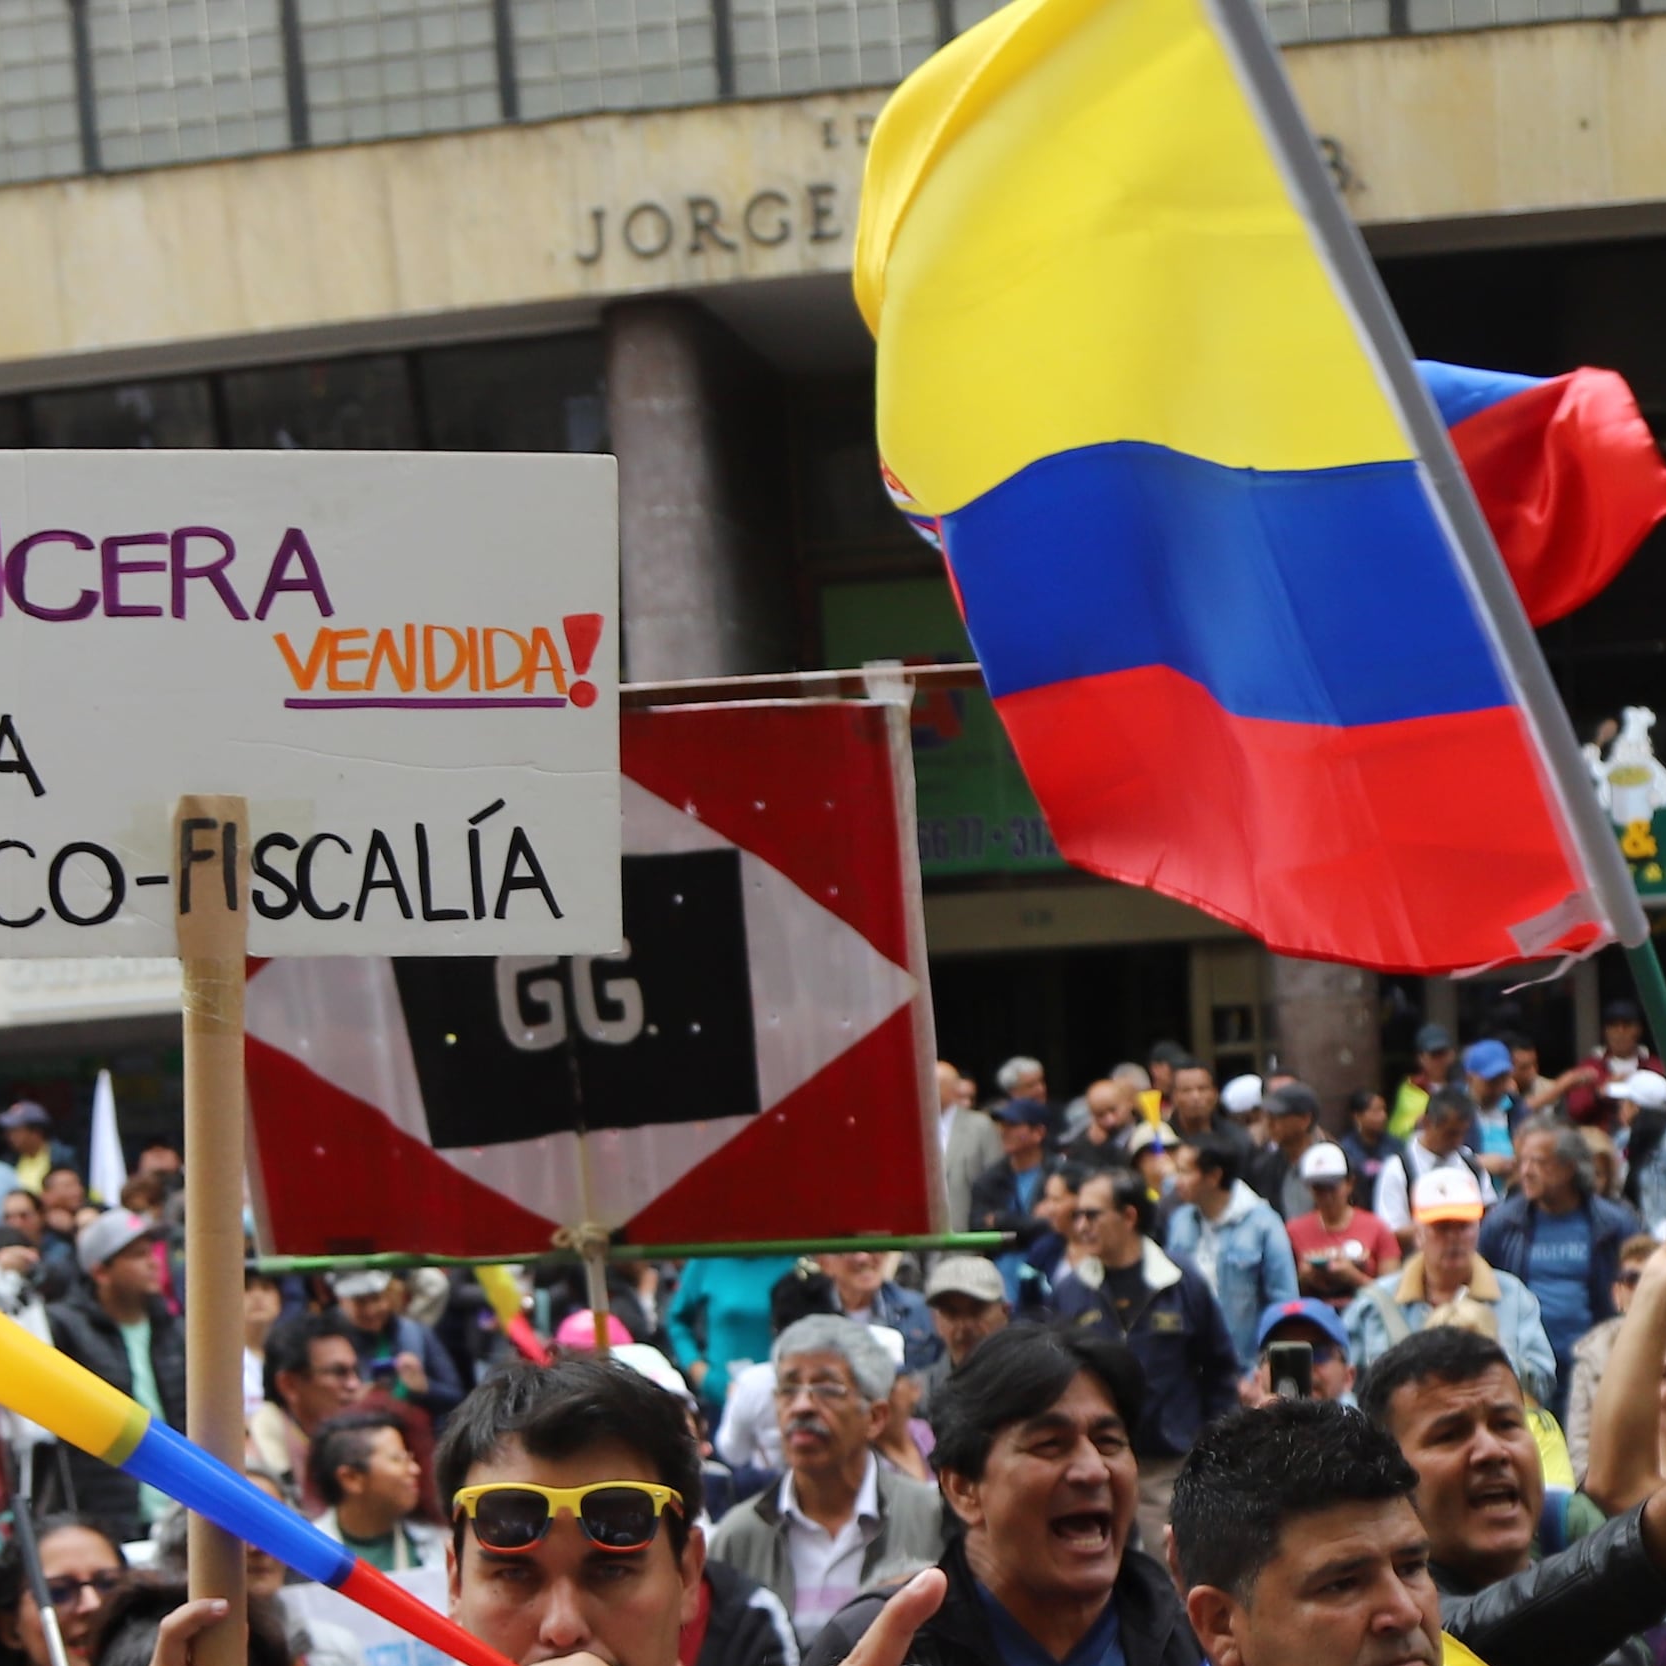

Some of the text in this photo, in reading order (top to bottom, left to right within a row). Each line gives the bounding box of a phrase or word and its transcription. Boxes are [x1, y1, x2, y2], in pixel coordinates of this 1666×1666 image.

[576, 184, 844, 266] JORGE
[274, 614, 604, 708] VENDIDA!
[494, 938, 643, 1051] GG
